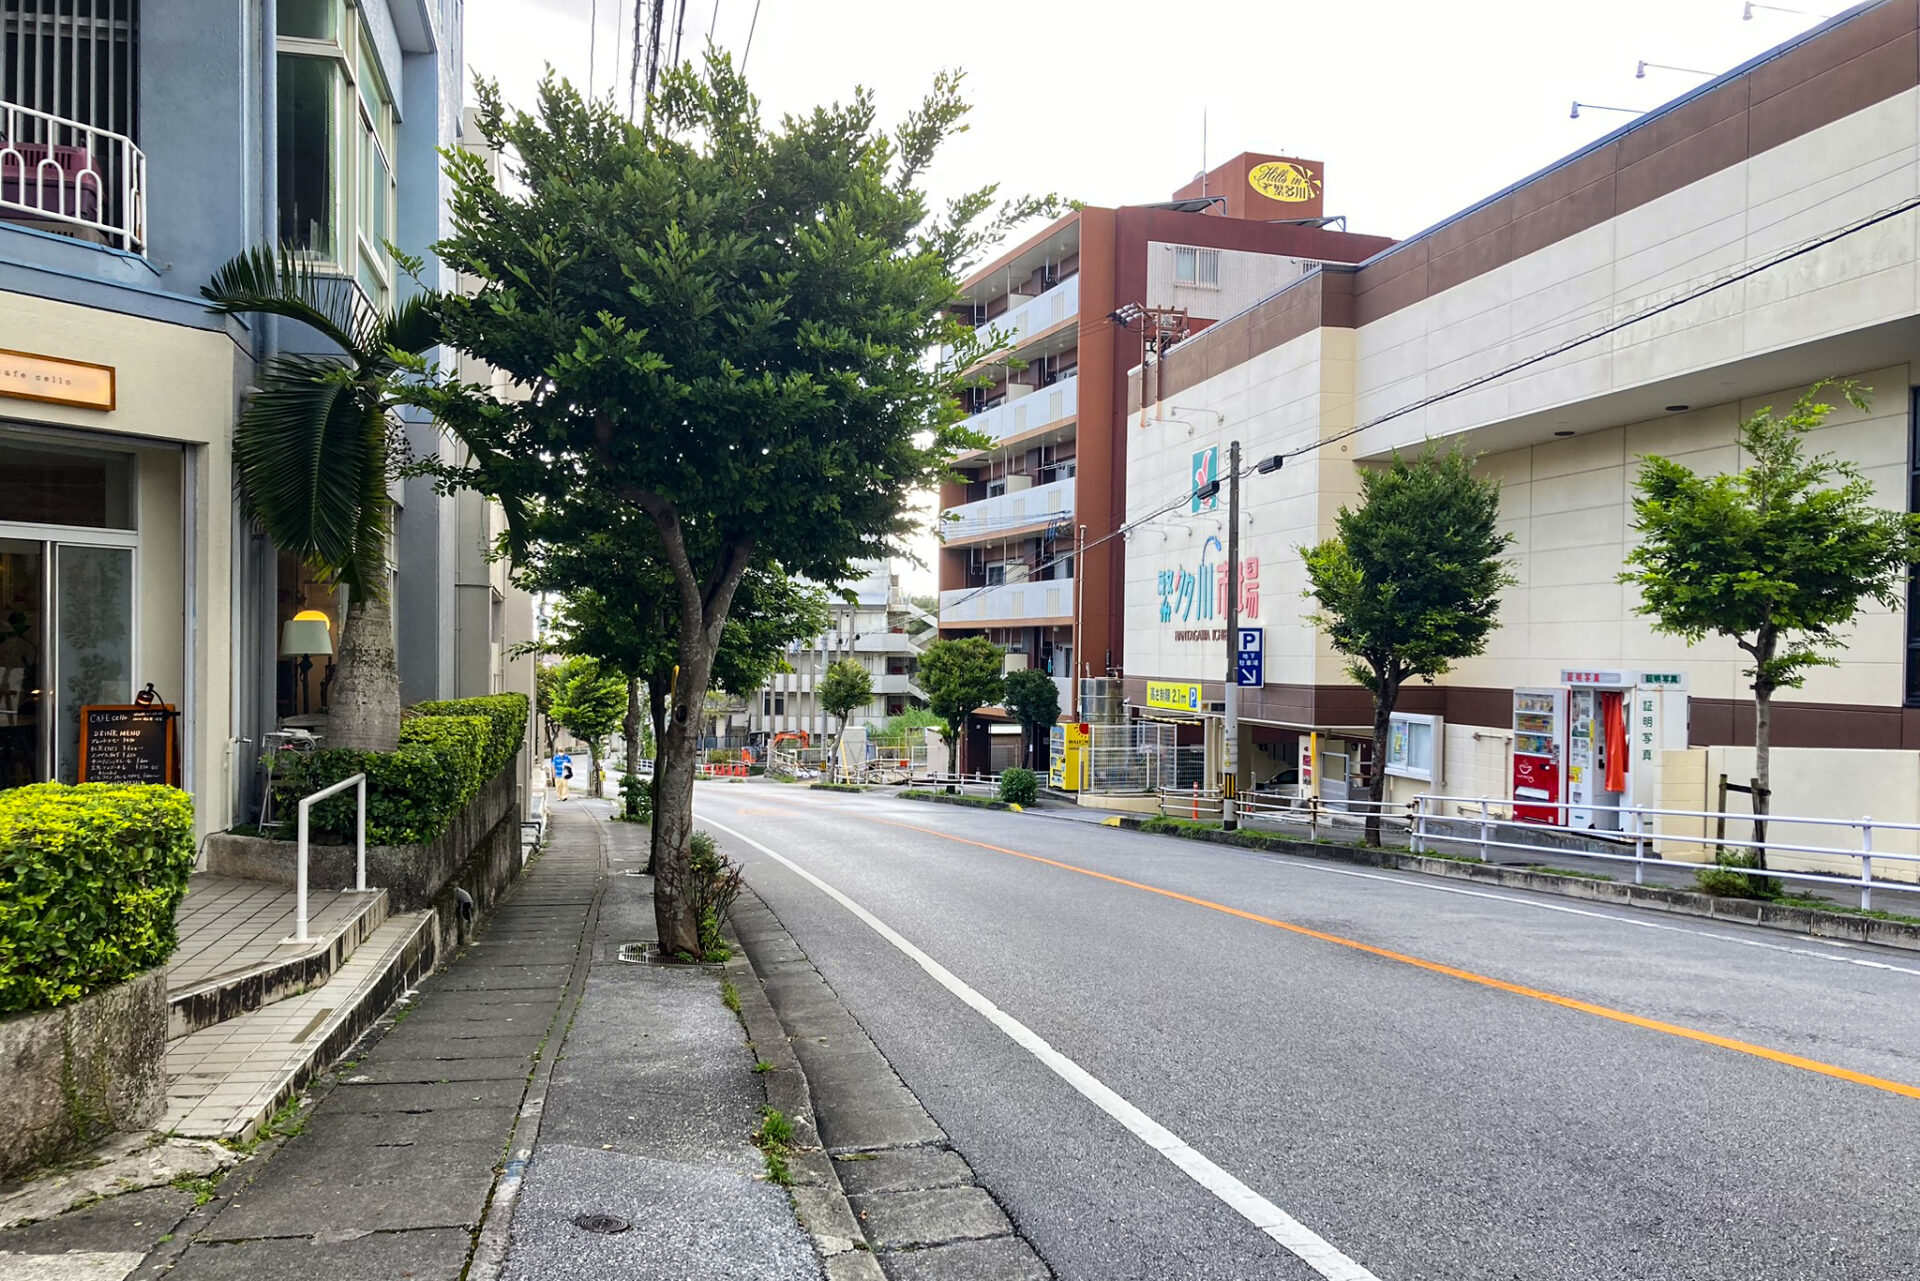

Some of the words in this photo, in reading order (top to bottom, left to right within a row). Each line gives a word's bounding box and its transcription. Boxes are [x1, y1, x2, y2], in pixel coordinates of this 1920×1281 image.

[1254, 165, 1289, 187] Hills
[1291, 175, 1302, 185] in
[0, 370, 26, 378] afe
[35, 375, 71, 385] cello
[1243, 633, 1256, 650] P
[93, 729, 118, 737] DRINK
[1642, 700, 1653, 761] 証明写真
